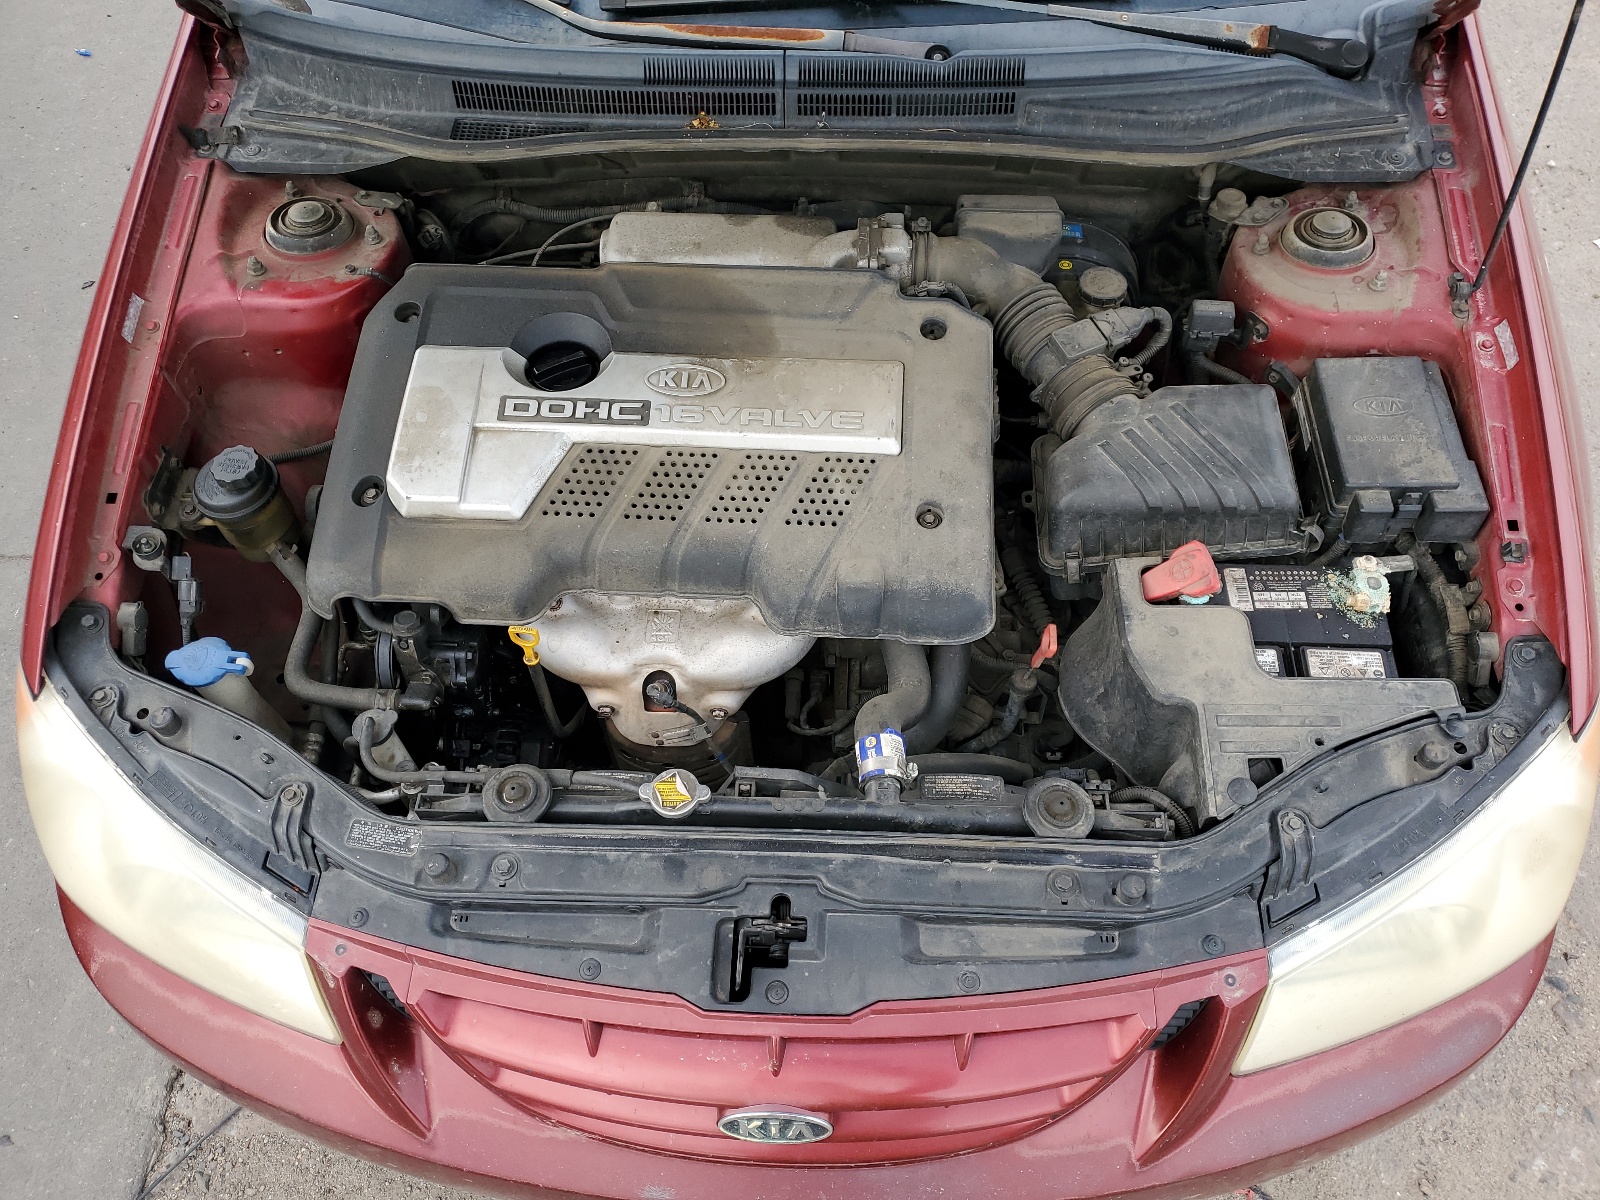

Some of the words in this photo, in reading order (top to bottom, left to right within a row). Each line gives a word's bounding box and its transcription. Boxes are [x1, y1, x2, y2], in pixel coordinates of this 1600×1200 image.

[657, 369, 712, 390] KIA
[503, 399, 645, 421] DOHC
[1364, 400, 1403, 413] KIA
[738, 1118, 815, 1140] KIA
